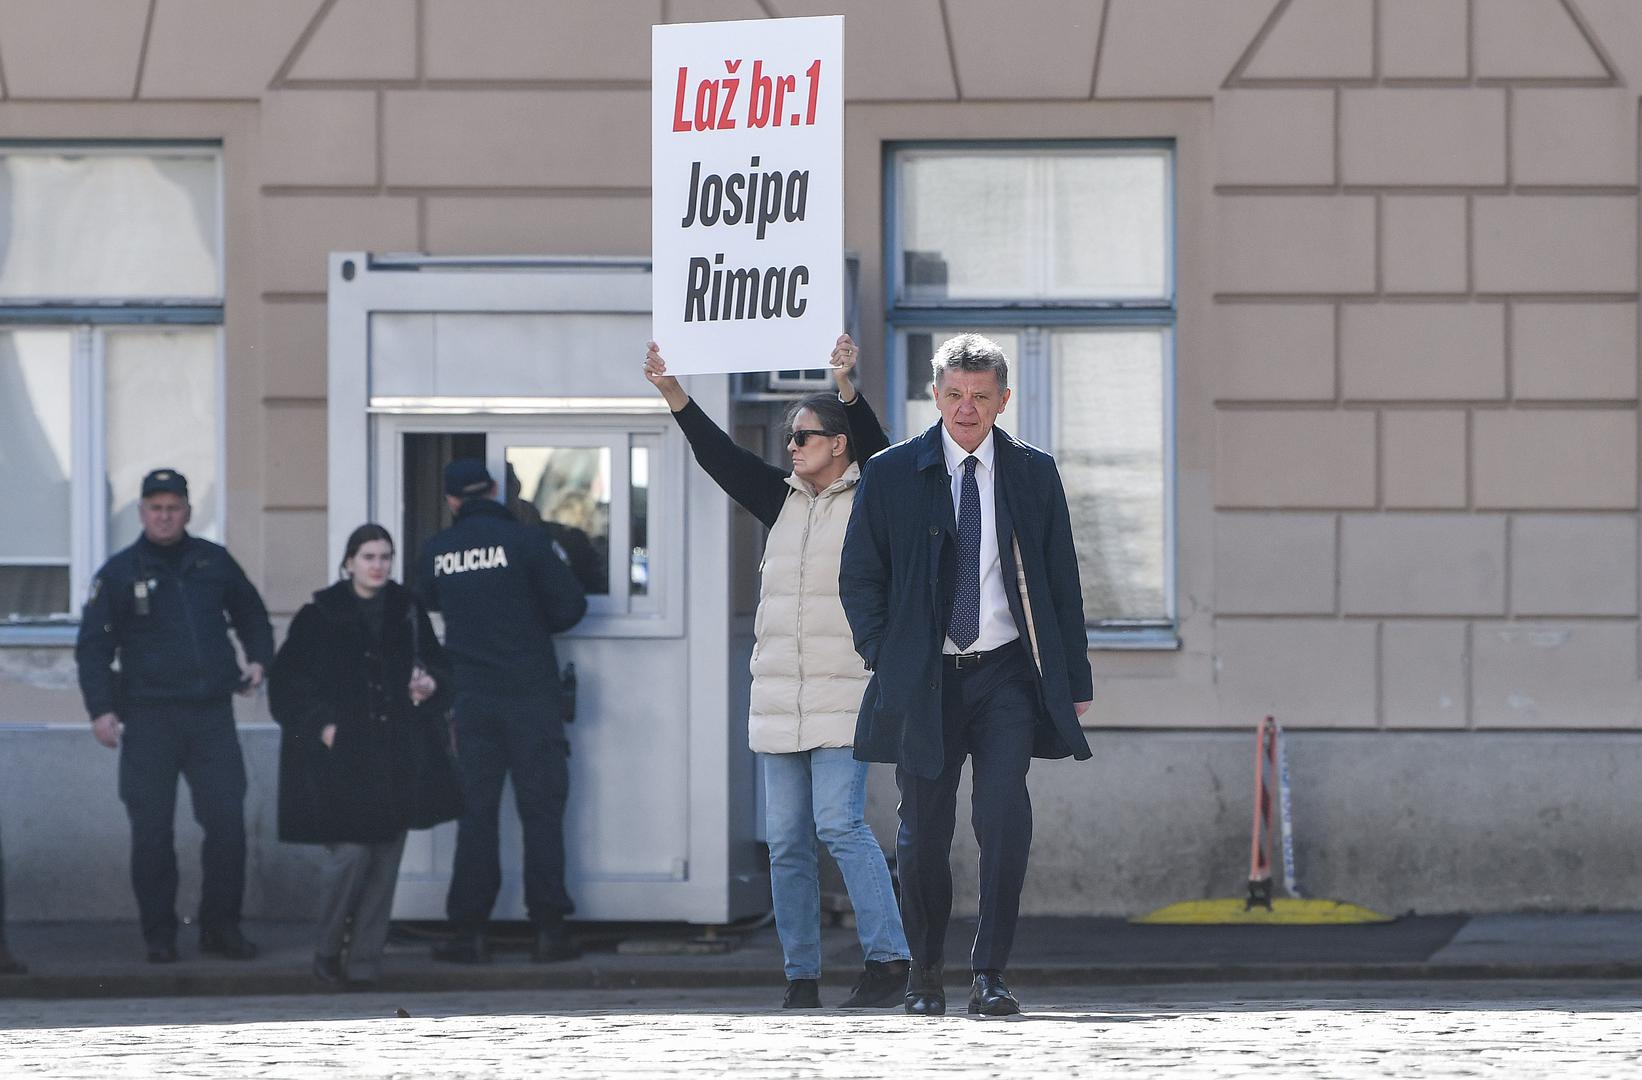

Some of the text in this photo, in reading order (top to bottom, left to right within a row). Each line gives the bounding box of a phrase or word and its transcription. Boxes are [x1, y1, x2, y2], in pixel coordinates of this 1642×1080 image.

[673, 59, 821, 133] Laž br.1
[682, 156, 810, 240] Josipa
[684, 253, 810, 322] Rimac
[434, 545, 508, 577] POLICIJA
